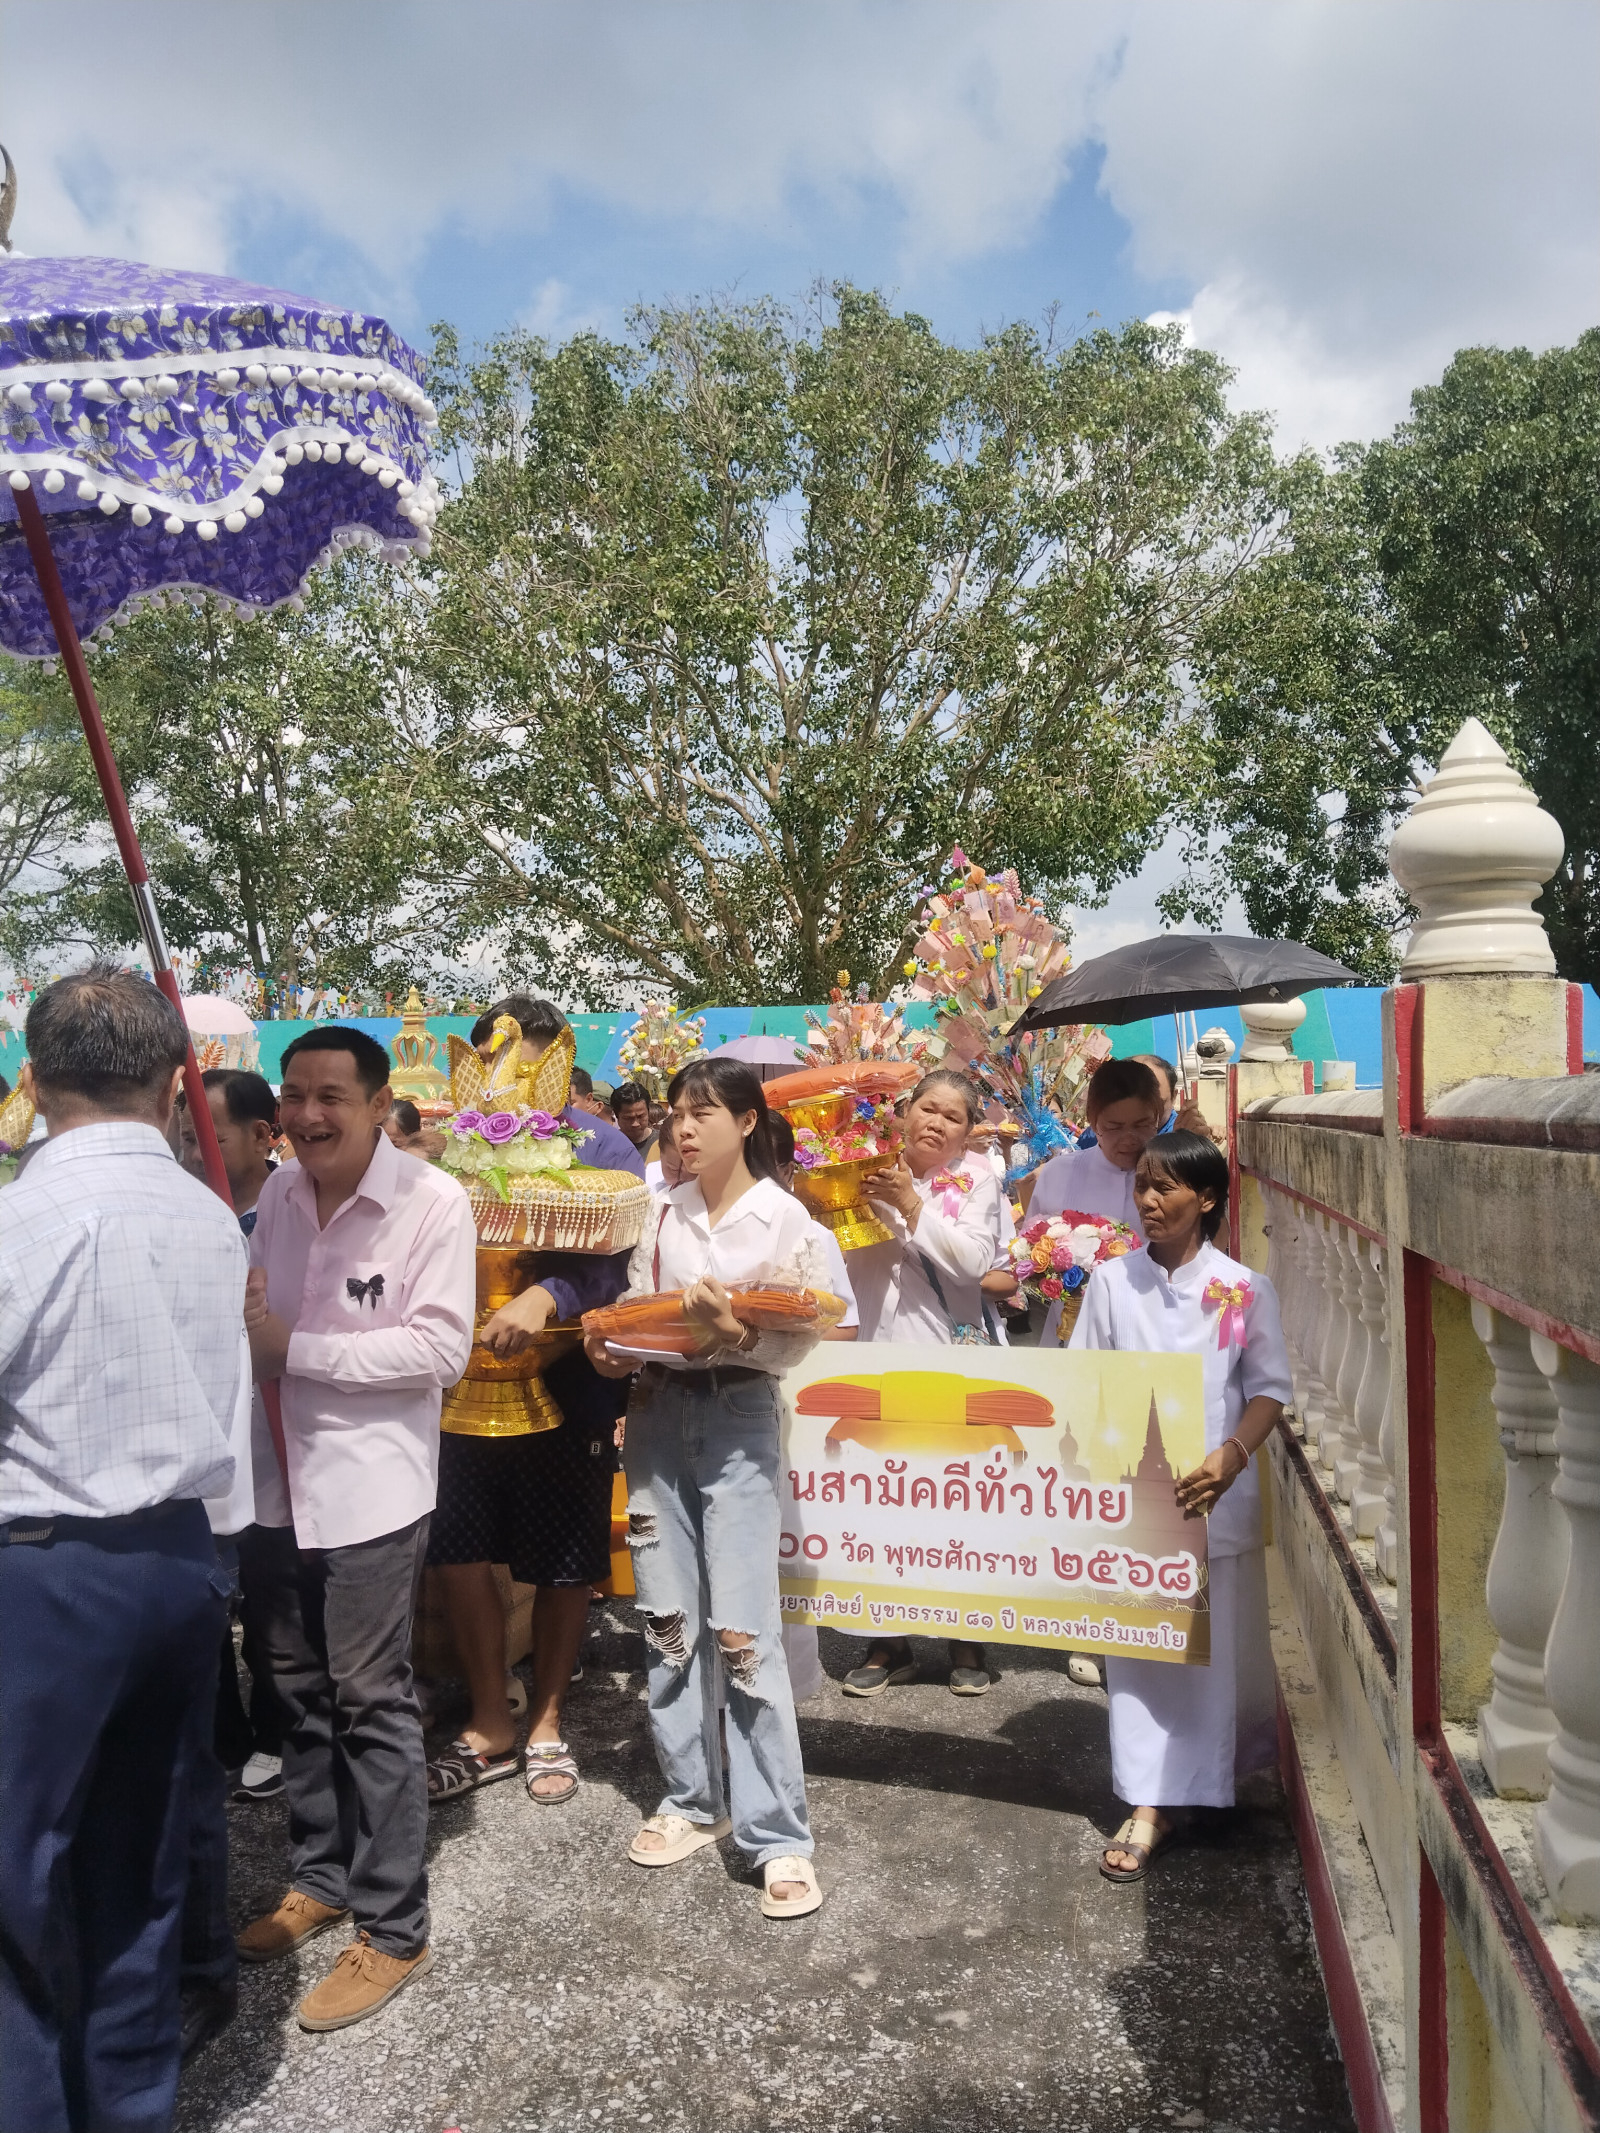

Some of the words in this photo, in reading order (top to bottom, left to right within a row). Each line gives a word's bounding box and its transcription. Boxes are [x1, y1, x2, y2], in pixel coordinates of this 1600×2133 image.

[788, 1451, 1126, 1523] นสามัคคีทั่วไทย
[841, 1531, 874, 1563] วัด
[884, 1539, 1037, 1577] พุทธศักราช
[1051, 1547, 1192, 1592] ๒๕๖๘
[869, 1603, 958, 1624] บูชาธรรม
[966, 1612, 993, 1628] ๘๑
[1002, 1609, 1015, 1629] ปี
[1023, 1616, 1184, 1648] หลวงพ่อธัมมชโย
